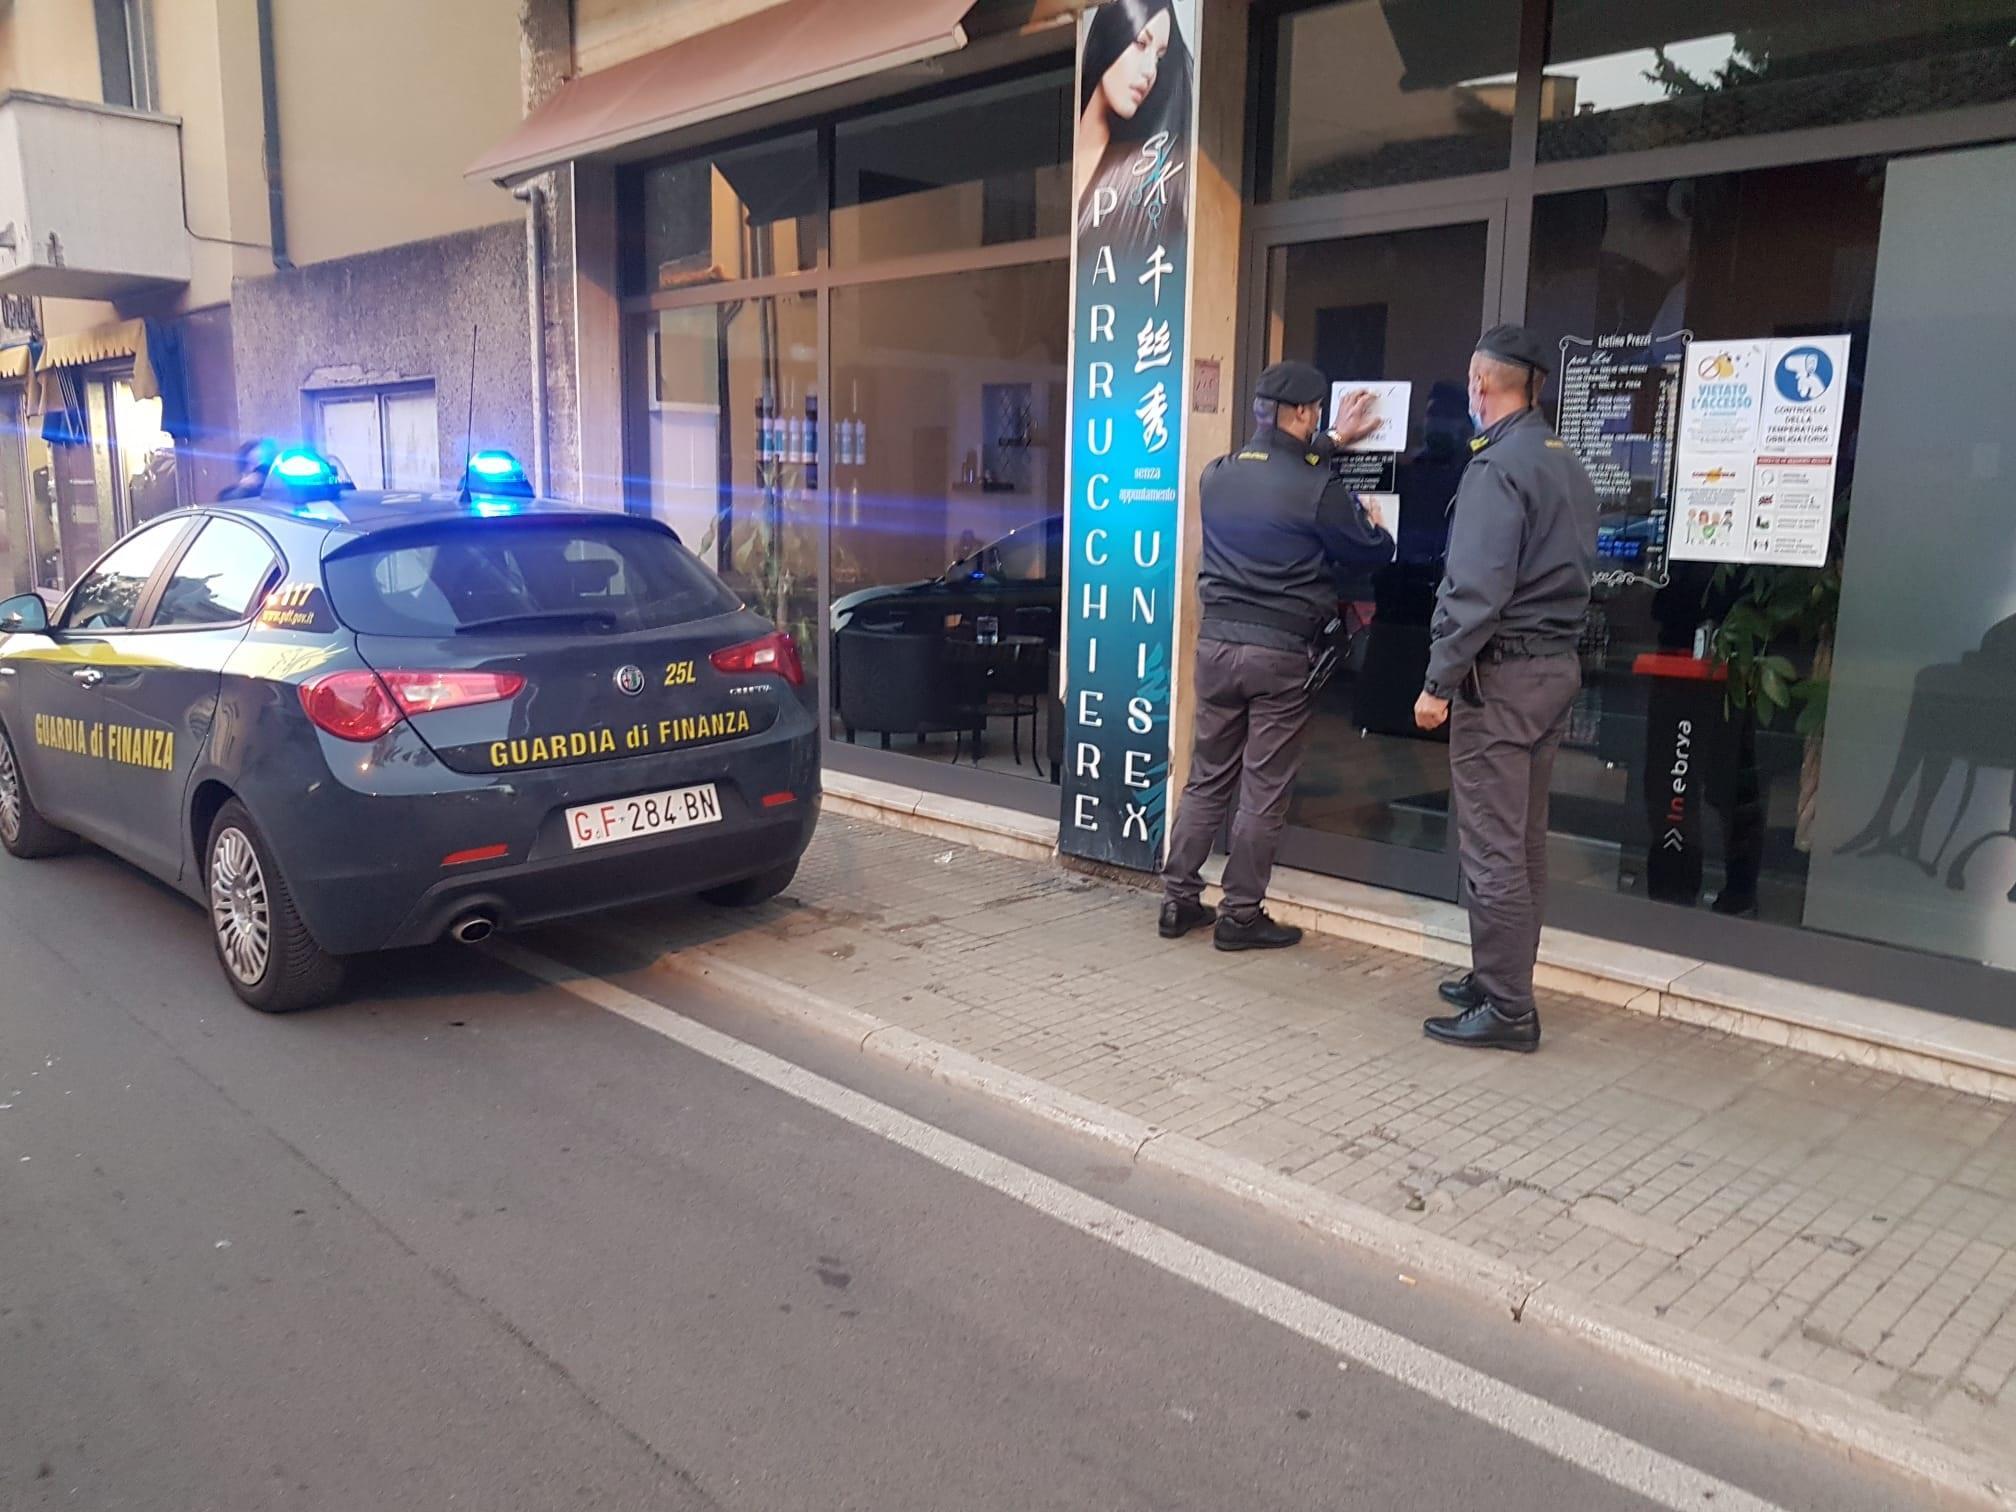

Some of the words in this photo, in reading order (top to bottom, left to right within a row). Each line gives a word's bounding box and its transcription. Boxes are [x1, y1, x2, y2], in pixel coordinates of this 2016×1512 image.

[1598, 335, 1625, 348] Listino
[1626, 333, 1653, 347] Prezzi
[1698, 383, 1748, 396] VIETATO
[1691, 396, 1752, 410] L'ACCESSO
[1774, 406, 1826, 415] CONTROLLO
[1785, 416, 1811, 424] DELLA
[1767, 425, 1829, 433] TEMPERATURA
[1134, 467, 1161, 480] senza
[1119, 487, 1176, 504] appuntamento
[1073, 187, 1118, 832] PARRUCCHIERE
[281, 582, 316, 607] 117
[664, 660, 697, 687] 25L
[1122, 529, 1160, 842] UNISEX
[35, 713, 87, 754] GUARDIA
[90, 722, 104, 758] di
[108, 724, 175, 771] FINANZA
[490, 728, 616, 768] GUARDIA
[626, 722, 650, 750] di
[659, 709, 750, 744] FINANZA
[627, 795, 678, 832] 284
[684, 788, 717, 821] BN
